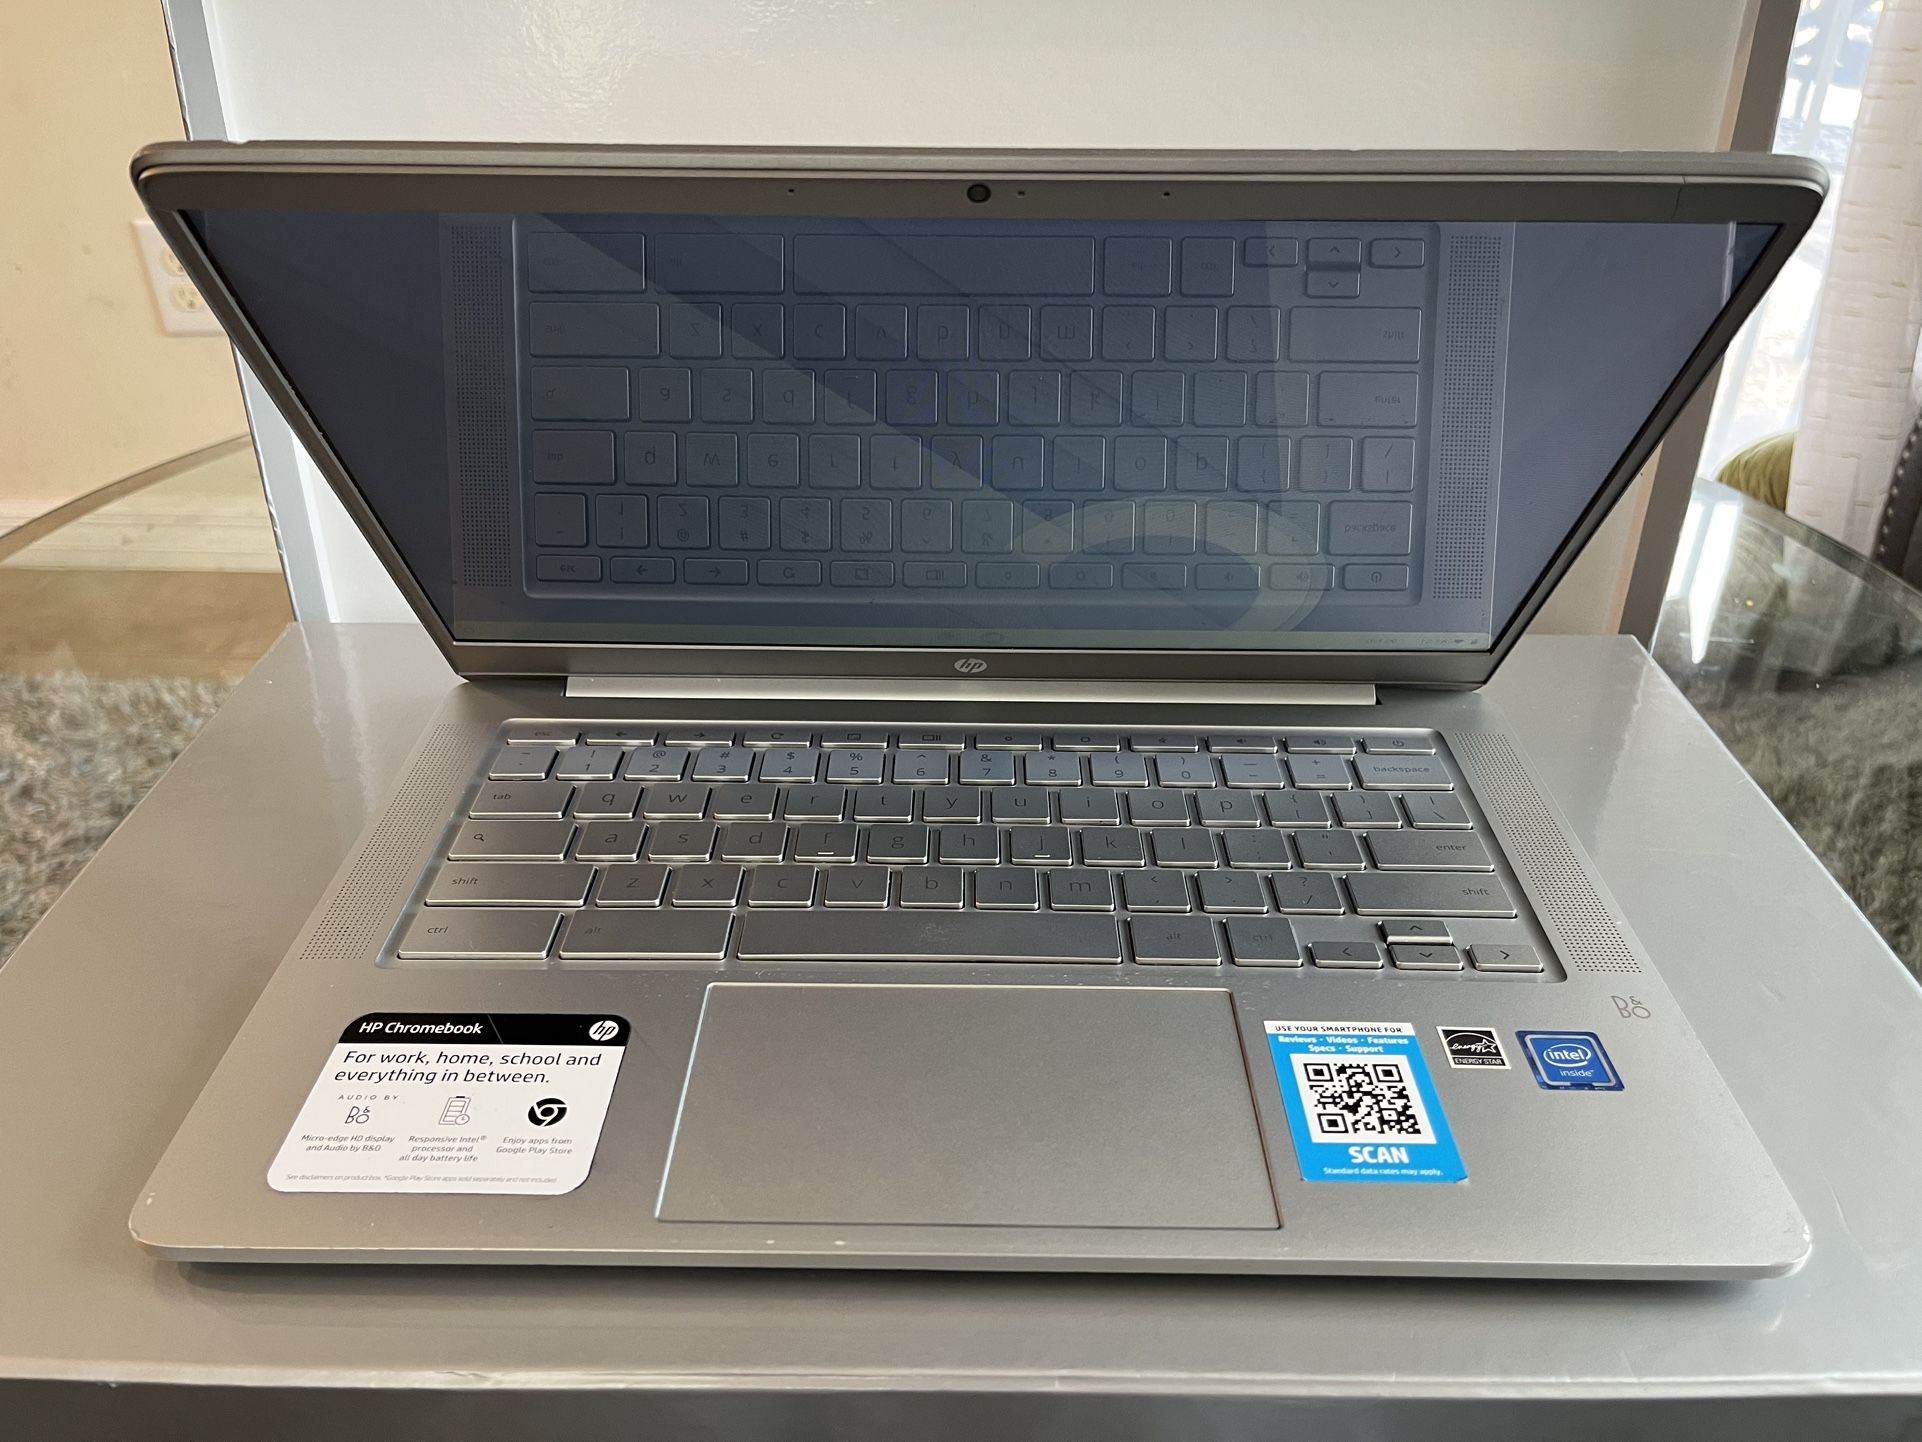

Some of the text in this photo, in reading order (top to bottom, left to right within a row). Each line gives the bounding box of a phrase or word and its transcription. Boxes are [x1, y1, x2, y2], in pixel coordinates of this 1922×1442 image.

[956, 658, 986, 673] hp
[653, 750, 666, 758] @
[786, 751, 795, 760] $
[850, 752, 862, 761] %
[649, 764, 659, 772] 2
[783, 765, 792, 774] 4
[850, 767, 859, 775] 5
[916, 767, 925, 776] 6
[1114, 769, 1123, 777] 9
[1373, 765, 1430, 774] backspace
[602, 793, 615, 806] q
[668, 794, 687, 803] w
[740, 794, 752, 803] e
[810, 795, 820, 804] r
[881, 796, 888, 806] t
[946, 797, 958, 809] y
[1014, 798, 1026, 807] u
[1221, 800, 1232, 813] p
[605, 833, 618, 843] a
[679, 834, 688, 843] s
[749, 833, 762, 844] d
[824, 833, 831, 844] f
[892, 835, 904, 849] g
[963, 834, 975, 846] h
[1106, 836, 1115, 849] k
[1436, 843, 1467, 851] enter
[451, 877, 478, 886] shift
[627, 878, 639, 888] z
[702, 878, 714, 888] x
[777, 878, 788, 888] c
[851, 879, 863, 888] v
[926, 877, 937, 889] b
[1000, 879, 1012, 890] n
[1070, 881, 1091, 891] m
[1462, 888, 1489, 896] shift
[359, 1022, 482, 1034] HP Chromebook
[590, 1020, 618, 1040] hp
[344, 1050, 602, 1066] For work, home, school and
[1548, 1049, 1584, 1060] intel
[335, 1069, 549, 1084] everything in between.
[364, 1135, 395, 1144] display
[409, 1135, 457, 1144] Responsive
[503, 1136, 525, 1145] Enjoy
[345, 1144, 360, 1152] by
[496, 1146, 526, 1155] Google
[529, 1147, 547, 1156] Play
[410, 1154, 427, 1163] day
[430, 1154, 462, 1163] battery
[1348, 1147, 1409, 1163] SCAN
